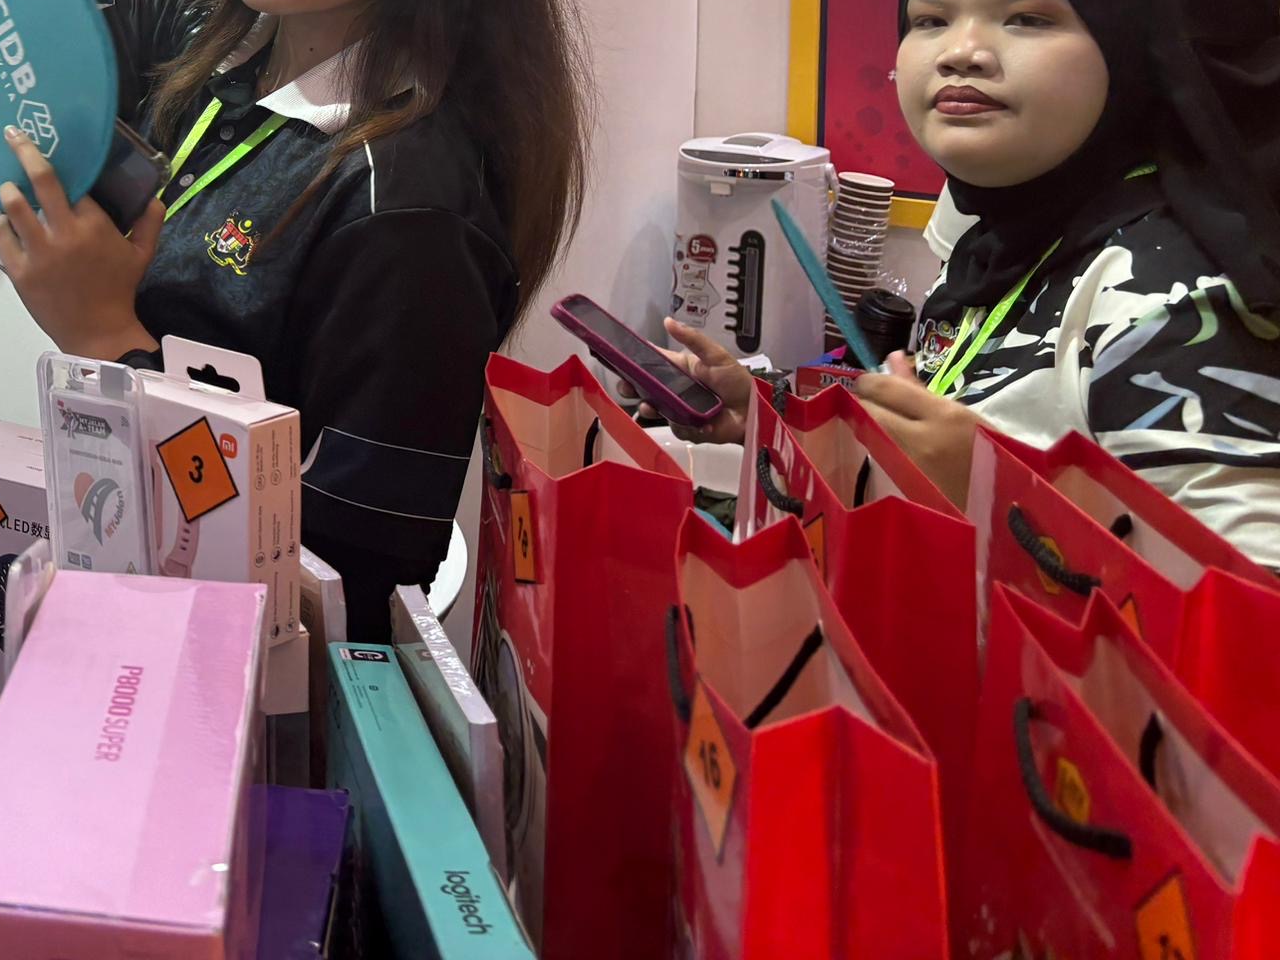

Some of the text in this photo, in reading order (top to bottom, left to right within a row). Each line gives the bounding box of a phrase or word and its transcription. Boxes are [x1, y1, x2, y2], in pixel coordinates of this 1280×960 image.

[691, 239, 701, 255] 5
[189, 455, 204, 484] 3
[94, 665, 144, 762] P8000 SUPER
[440, 870, 494, 935] logitech
